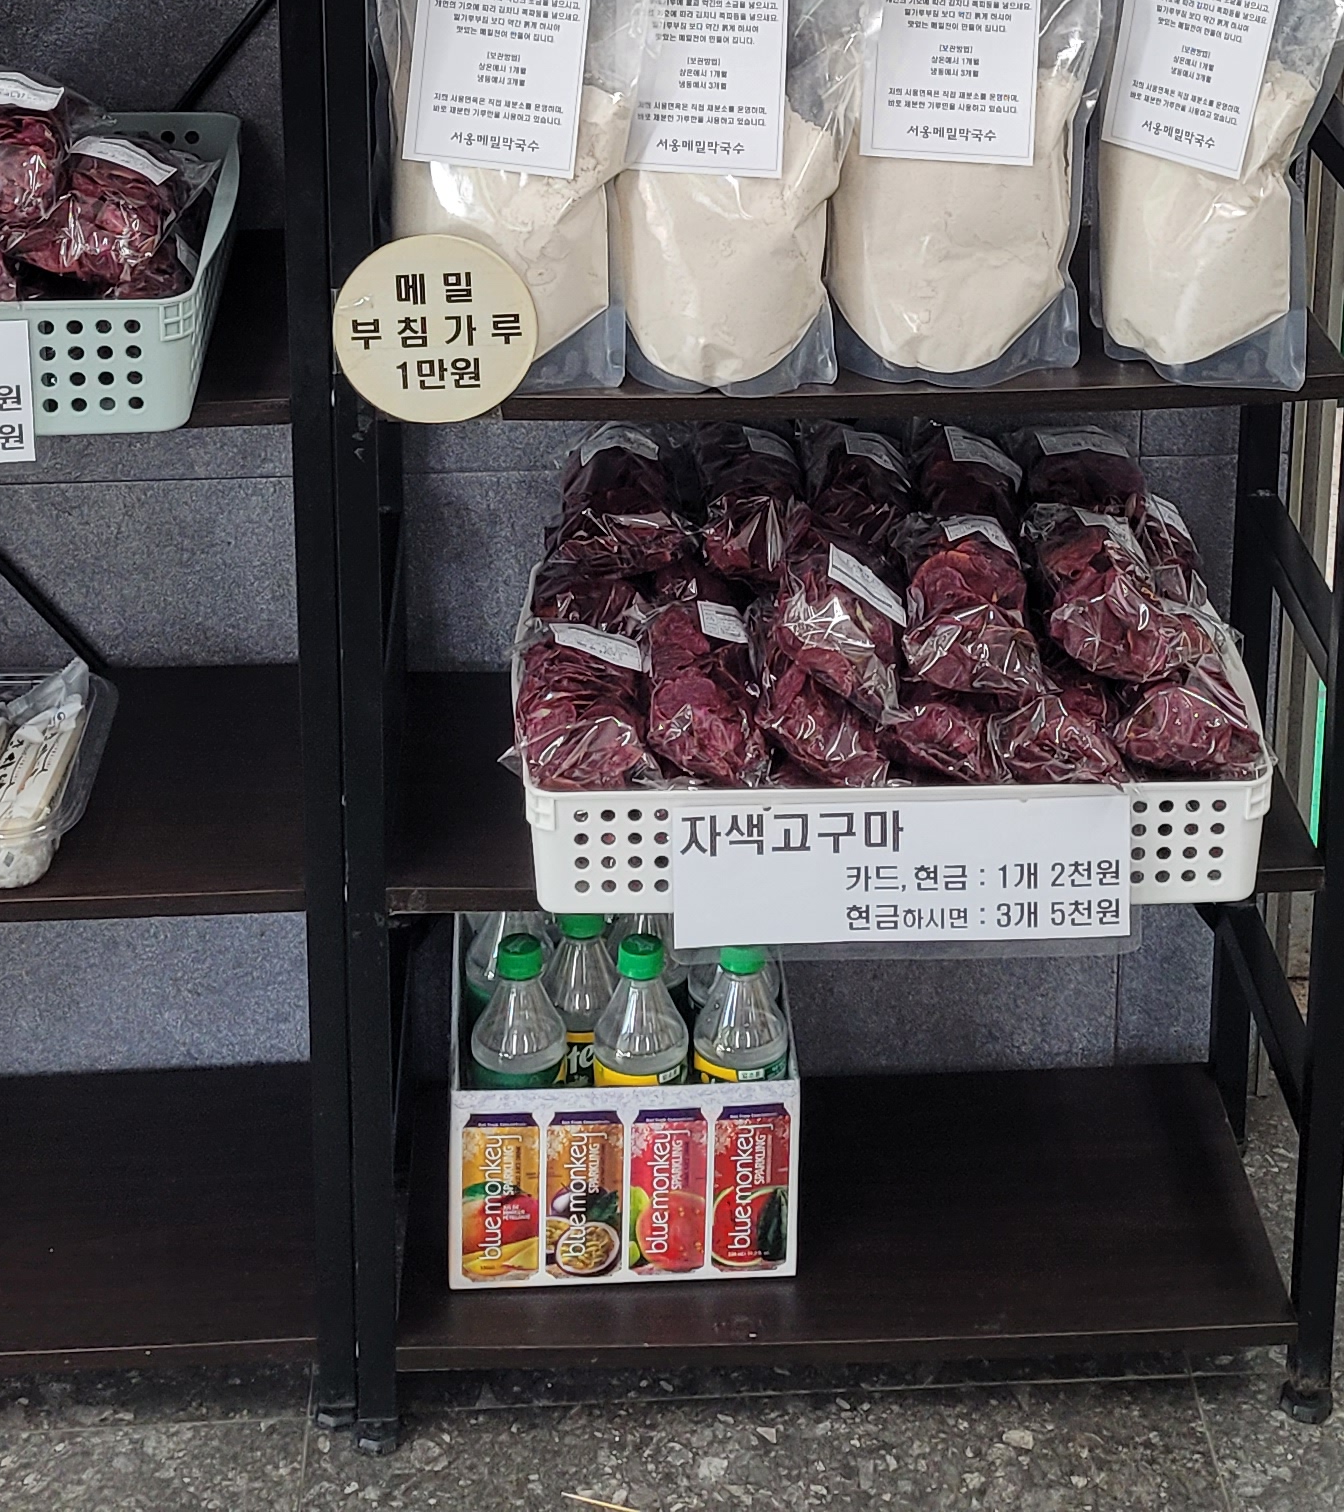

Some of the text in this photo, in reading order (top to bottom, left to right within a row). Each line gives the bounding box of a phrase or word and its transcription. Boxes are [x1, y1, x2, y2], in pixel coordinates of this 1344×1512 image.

[450, 131, 540, 153] 서웅메밀막국수
[656, 138, 746, 155] 서웅메밀막국수
[906, 125, 997, 142] 서웅메밀막국수
[395, 356, 483, 391] 1만원
[679, 809, 905, 858] 자색고구마
[997, 862, 1040, 892] 1개
[1049, 859, 1122, 890] 2천원
[844, 898, 1122, 933] 현금하시면 3개 5천원
